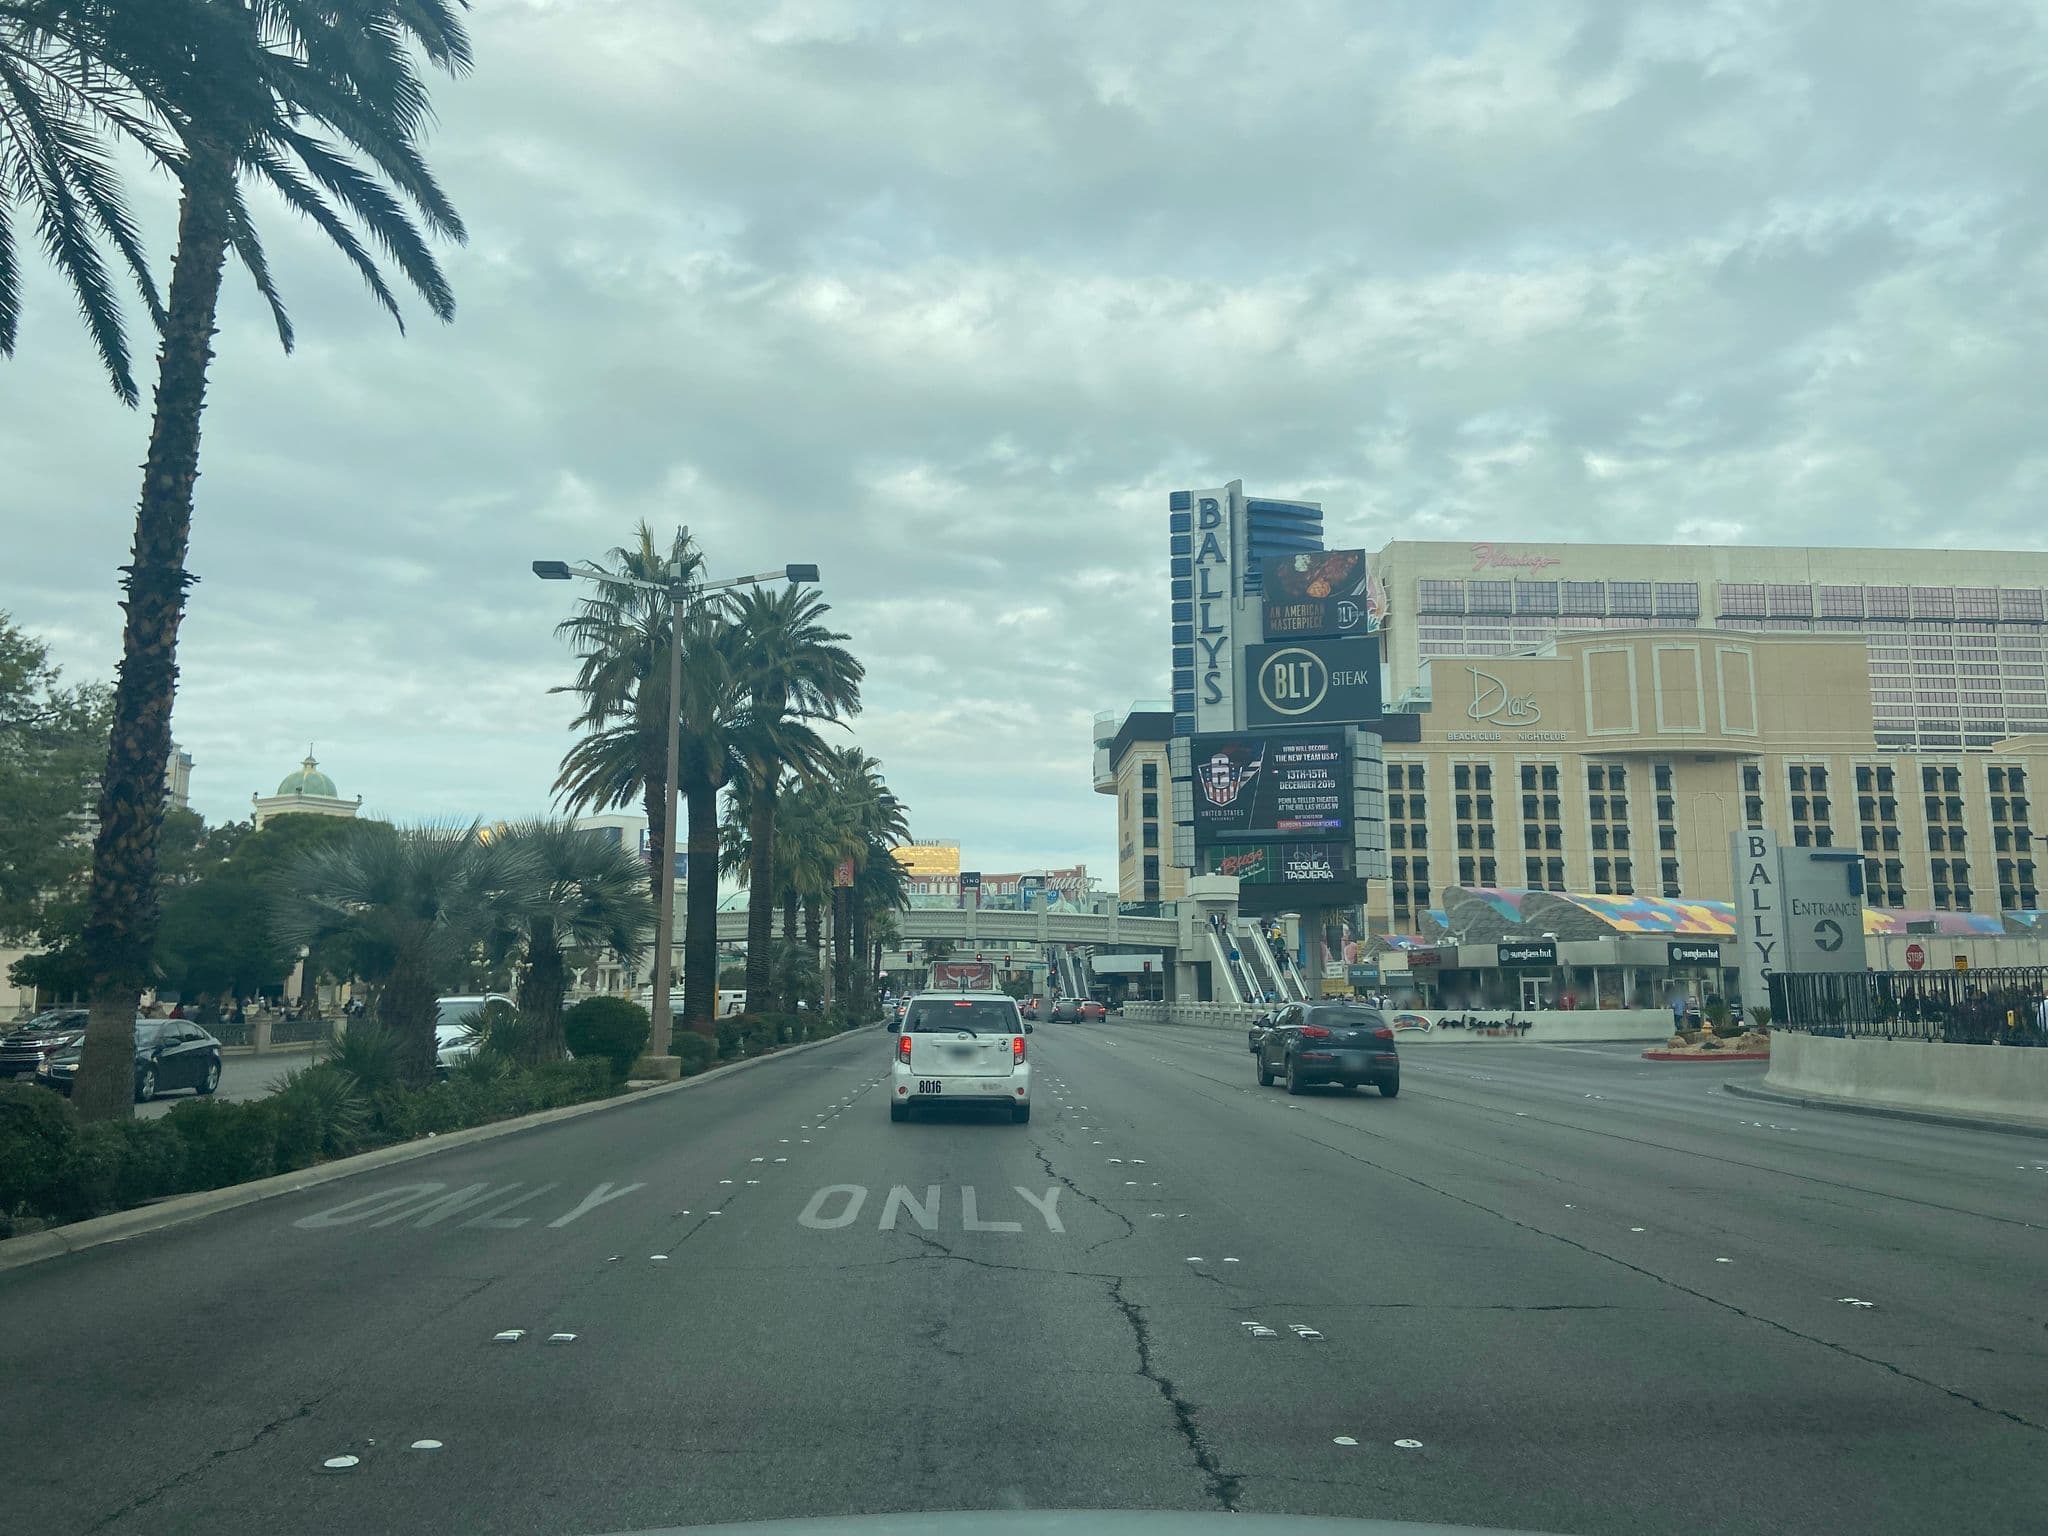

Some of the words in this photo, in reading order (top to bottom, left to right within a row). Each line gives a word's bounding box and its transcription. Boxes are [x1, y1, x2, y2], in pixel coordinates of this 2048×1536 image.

[1471, 542, 1560, 575] Flamingo
[1195, 497, 1228, 705] BALLYS
[1274, 662, 1313, 699] BLT
[1332, 670, 1368, 686] STEAK
[1465, 664, 1541, 727] Drai's
[1447, 732, 1476, 741] BEACH
[1479, 732, 1501, 741] CLUB
[1518, 732, 1567, 741] NIGHTCLUB
[1288, 753, 1302, 762] NEW
[1303, 753, 1321, 761] TEAM
[1321, 752, 1338, 760] USA?
[1280, 780, 1316, 790] DECEMBER
[1317, 779, 1336, 789] 2019
[1223, 809, 1244, 817] STATES
[1287, 861, 1330, 870] TEQUILA
[1285, 870, 1334, 879] TAQUERIA
[1792, 898, 1858, 917] ENTRANCE
[1510, 949, 1539, 960] sunglass
[1539, 949, 1552, 958] hut
[1682, 949, 1707, 960] sunglass
[1708, 949, 1719, 958] hut
[1907, 952, 1923, 962] STOP
[919, 1080, 942, 1094] 8016
[291, 1181, 648, 1231] ONLY
[799, 1183, 1067, 1234] ONLY
